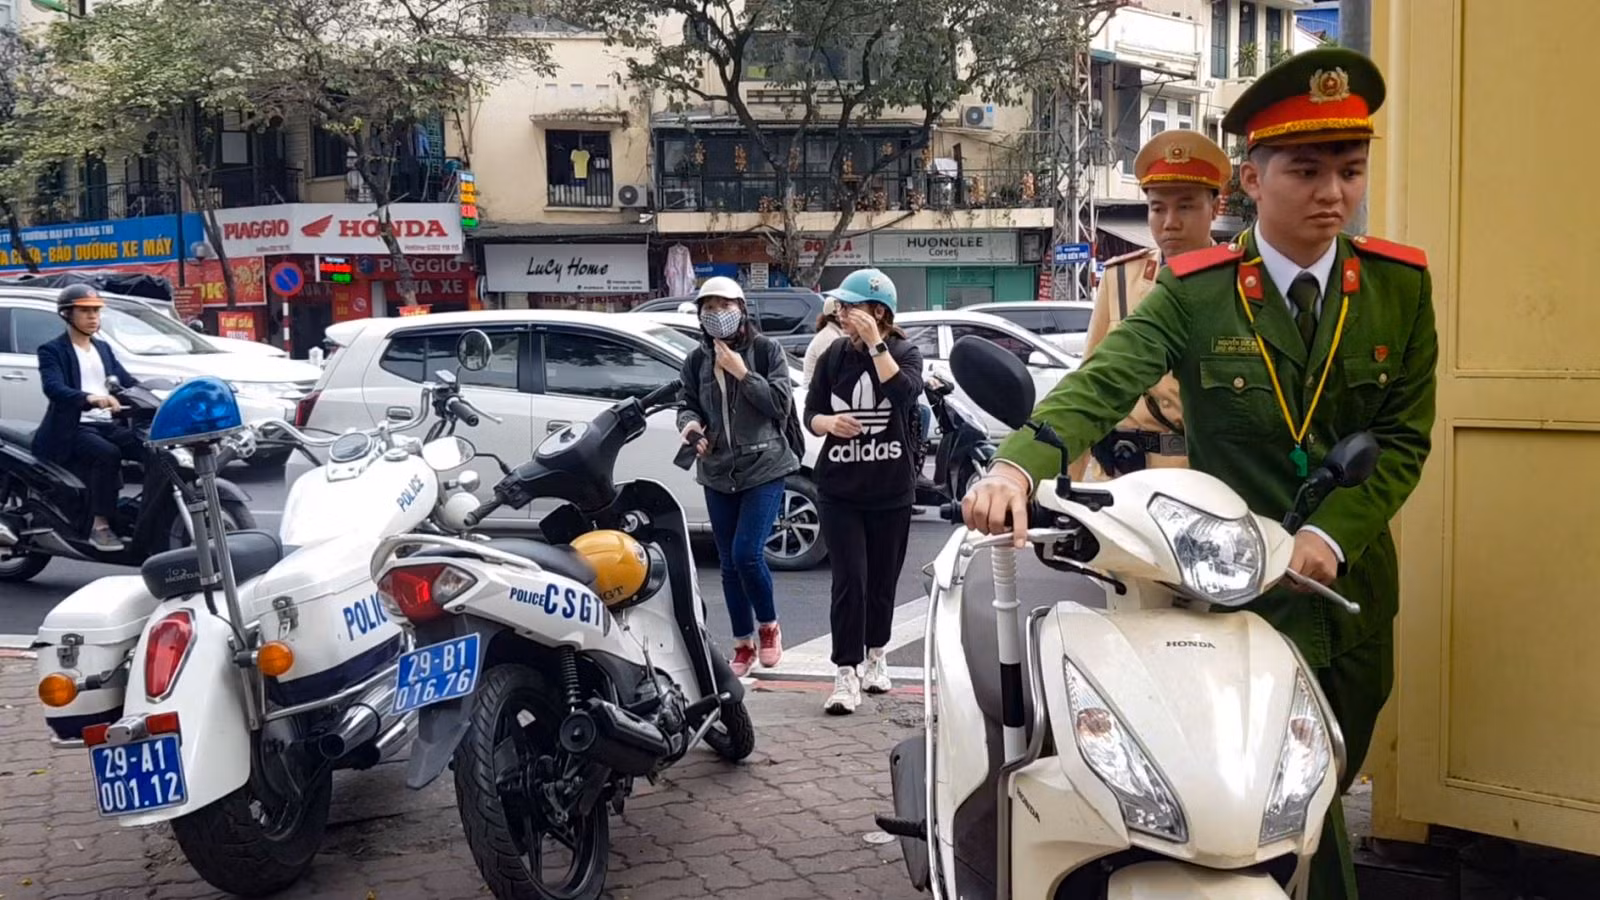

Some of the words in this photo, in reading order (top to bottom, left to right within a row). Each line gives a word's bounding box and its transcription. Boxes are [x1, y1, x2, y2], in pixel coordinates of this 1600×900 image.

[223, 218, 289, 241] PIAGGIO
[338, 219, 448, 238] HONDA
[122, 240, 138, 258] XE
[143, 233, 172, 257] MÁY
[567, 256, 609, 276] Home
[441, 280, 464, 294] XE
[828, 438, 902, 463] adidas
[396, 474, 424, 512] POLICE
[342, 591, 388, 641] POLIC
[1166, 640, 1216, 649] HONDA
[408, 641, 466, 684] 29-B1
[396, 668, 472, 710] 016.76
[102, 740, 166, 778] 29-A1
[101, 771, 181, 811] 001.12
[1016, 787, 1041, 823] HONDA
